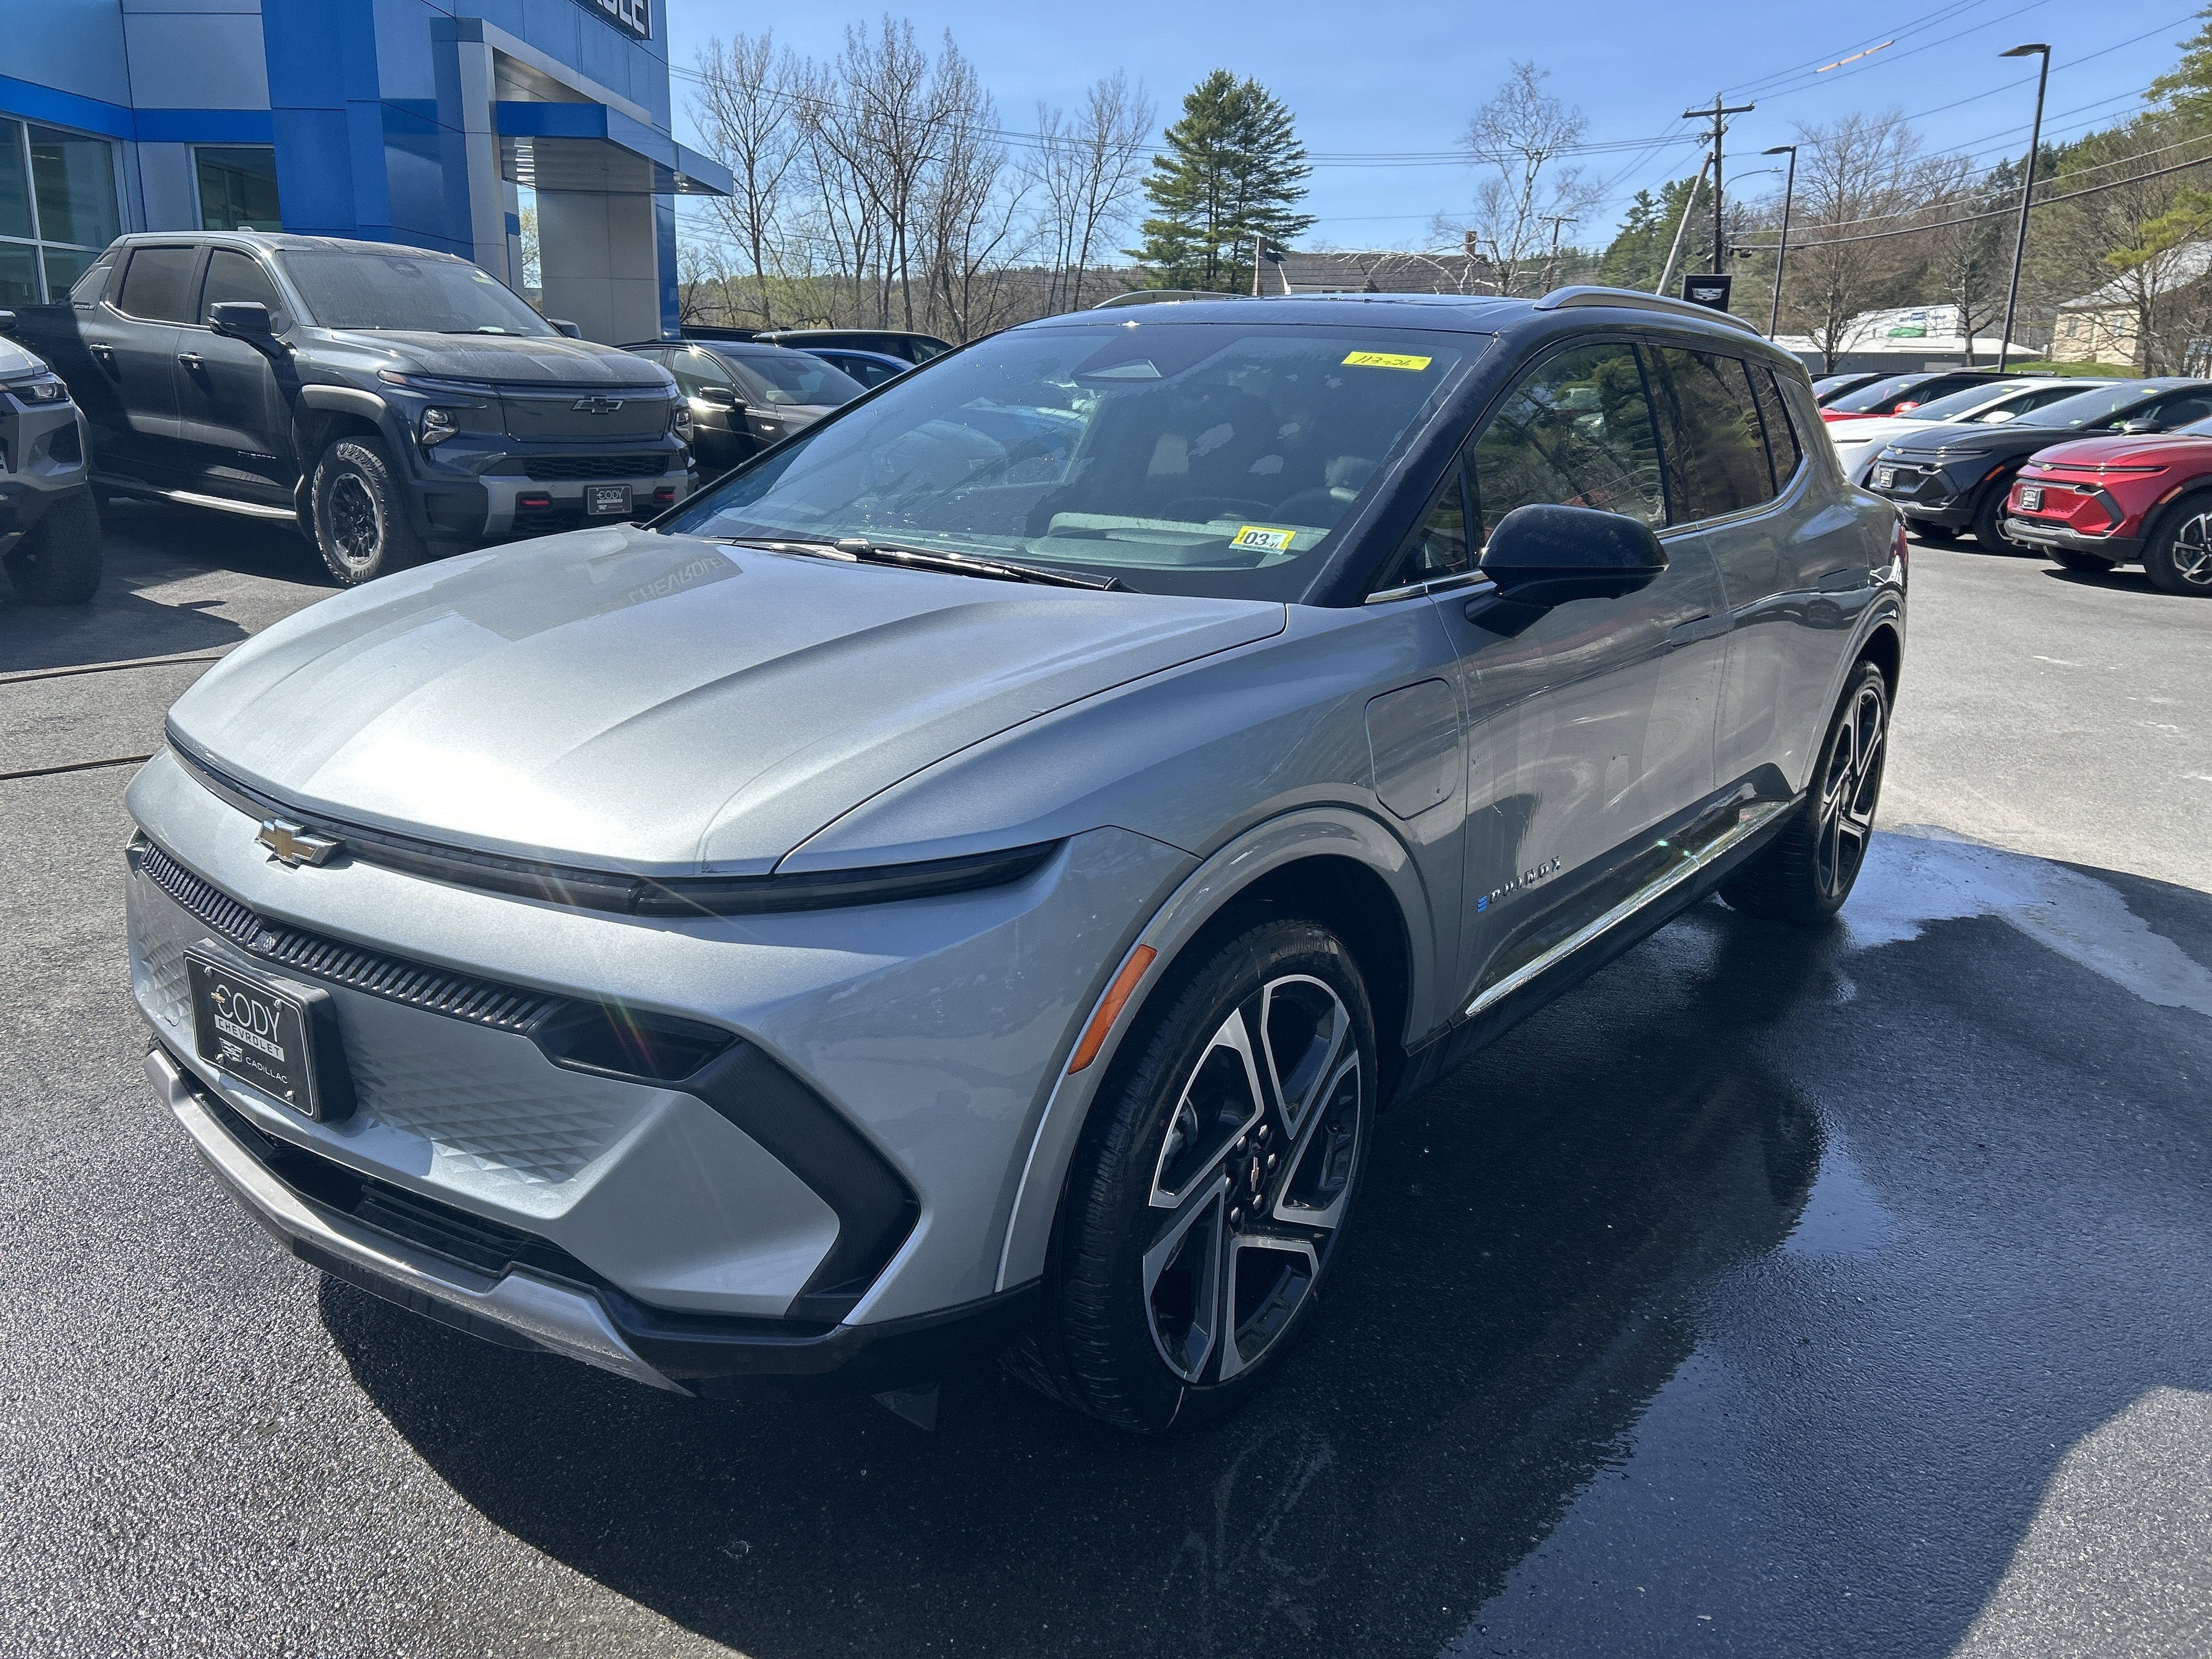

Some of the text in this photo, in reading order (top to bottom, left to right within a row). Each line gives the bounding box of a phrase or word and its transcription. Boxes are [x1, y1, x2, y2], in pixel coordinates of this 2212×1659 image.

[598, 490, 623, 500] CODY
[1243, 532, 1270, 546] 03
[213, 984, 280, 1042] CODY
[219, 1018, 280, 1057] CHEVROLET
[245, 1057, 288, 1084] CADILLAC
